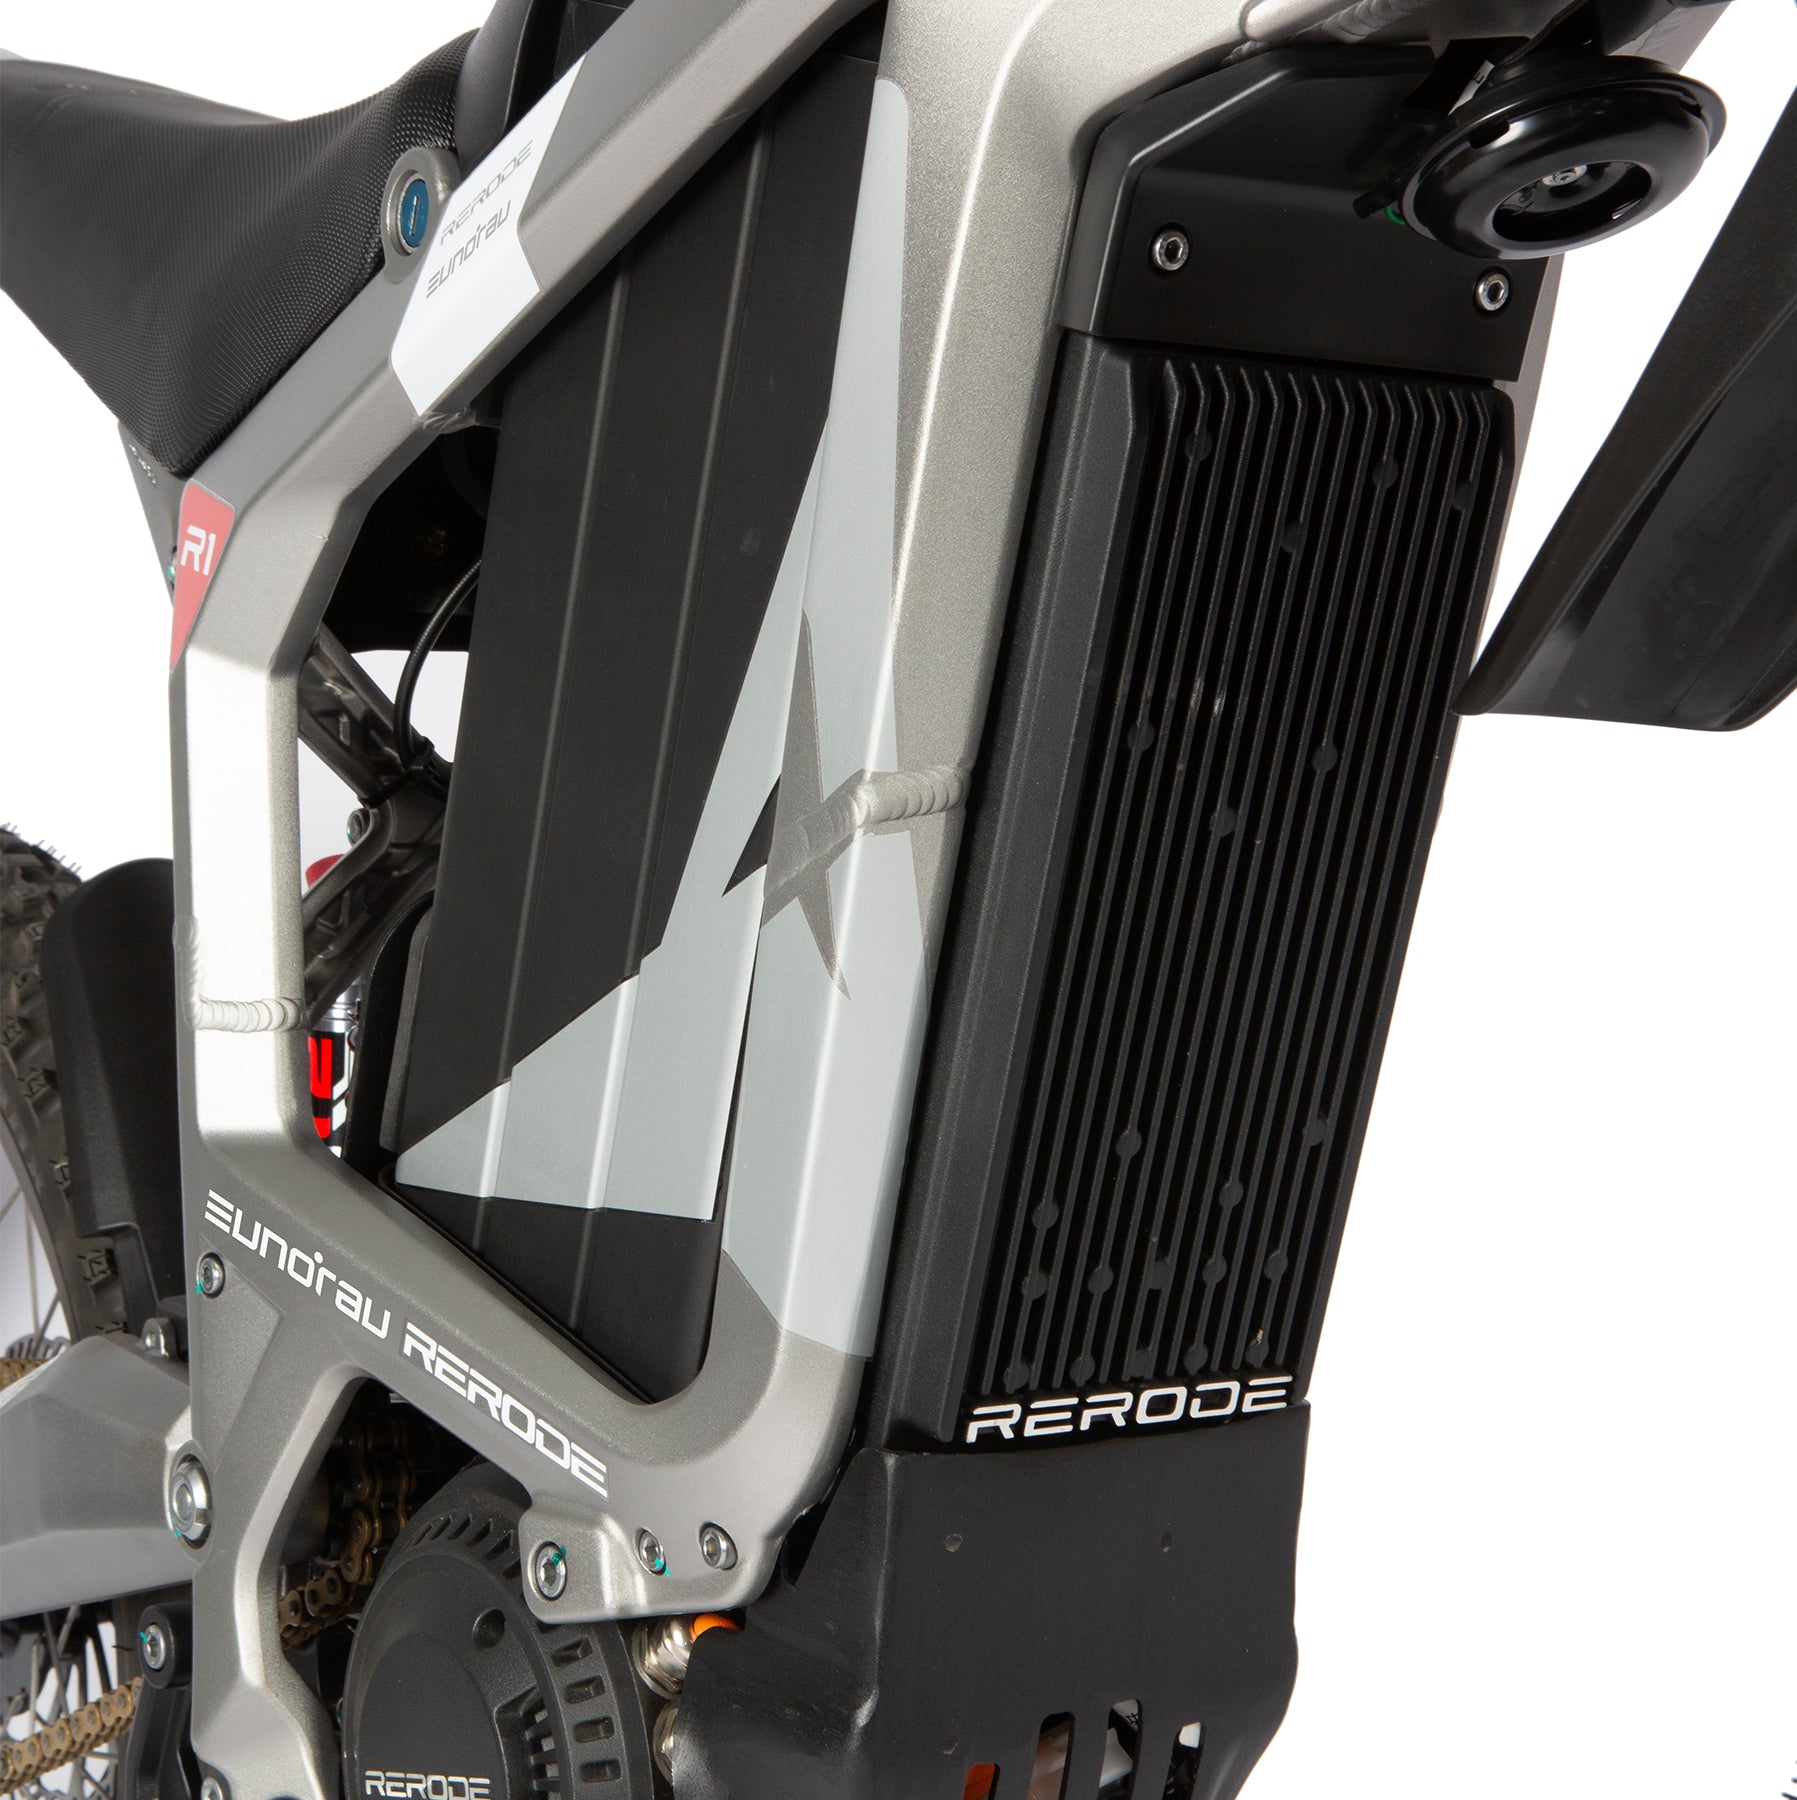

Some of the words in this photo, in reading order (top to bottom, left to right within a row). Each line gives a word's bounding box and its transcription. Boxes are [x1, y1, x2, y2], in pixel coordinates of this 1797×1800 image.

[440, 140, 533, 246] RERODE
[180, 525, 217, 576] R1
[403, 1321, 608, 1499] RERODE
[966, 1376, 1293, 1444] RERODE
[365, 1770, 491, 1800] RERODE
